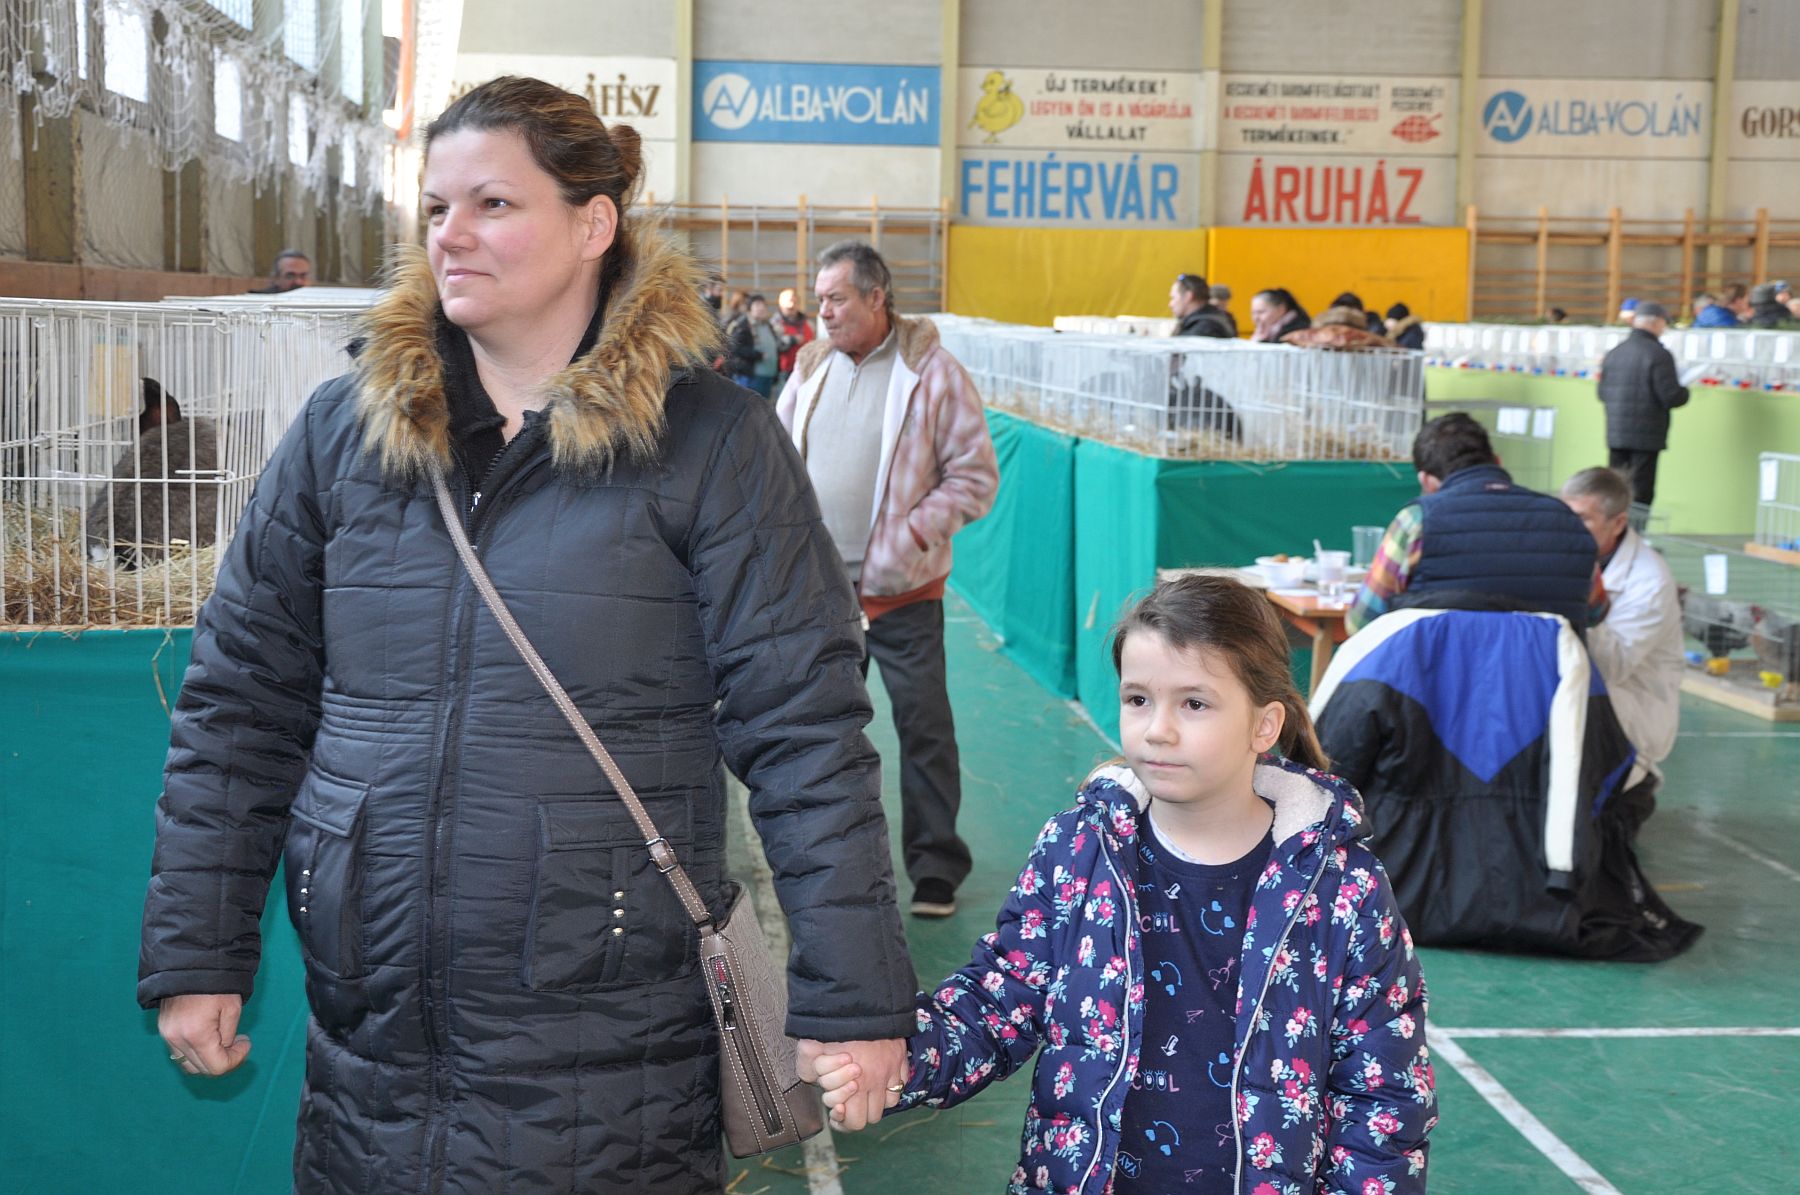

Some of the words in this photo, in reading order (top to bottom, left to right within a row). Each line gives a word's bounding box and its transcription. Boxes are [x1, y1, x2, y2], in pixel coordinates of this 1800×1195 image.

[757, 79, 928, 125] ALBA-VOLÁN
[1072, 75, 1168, 95] TERMÉKEK!
[1066, 120, 1147, 141] VÁLLALAT
[1536, 93, 1702, 137] ALBA-VOLÁN
[1741, 105, 1800, 139] GOR
[960, 153, 1180, 222] FEHÉRVÁR
[1243, 157, 1425, 224] ÁRUHÁZ
[1132, 1069, 1180, 1093] COOL
